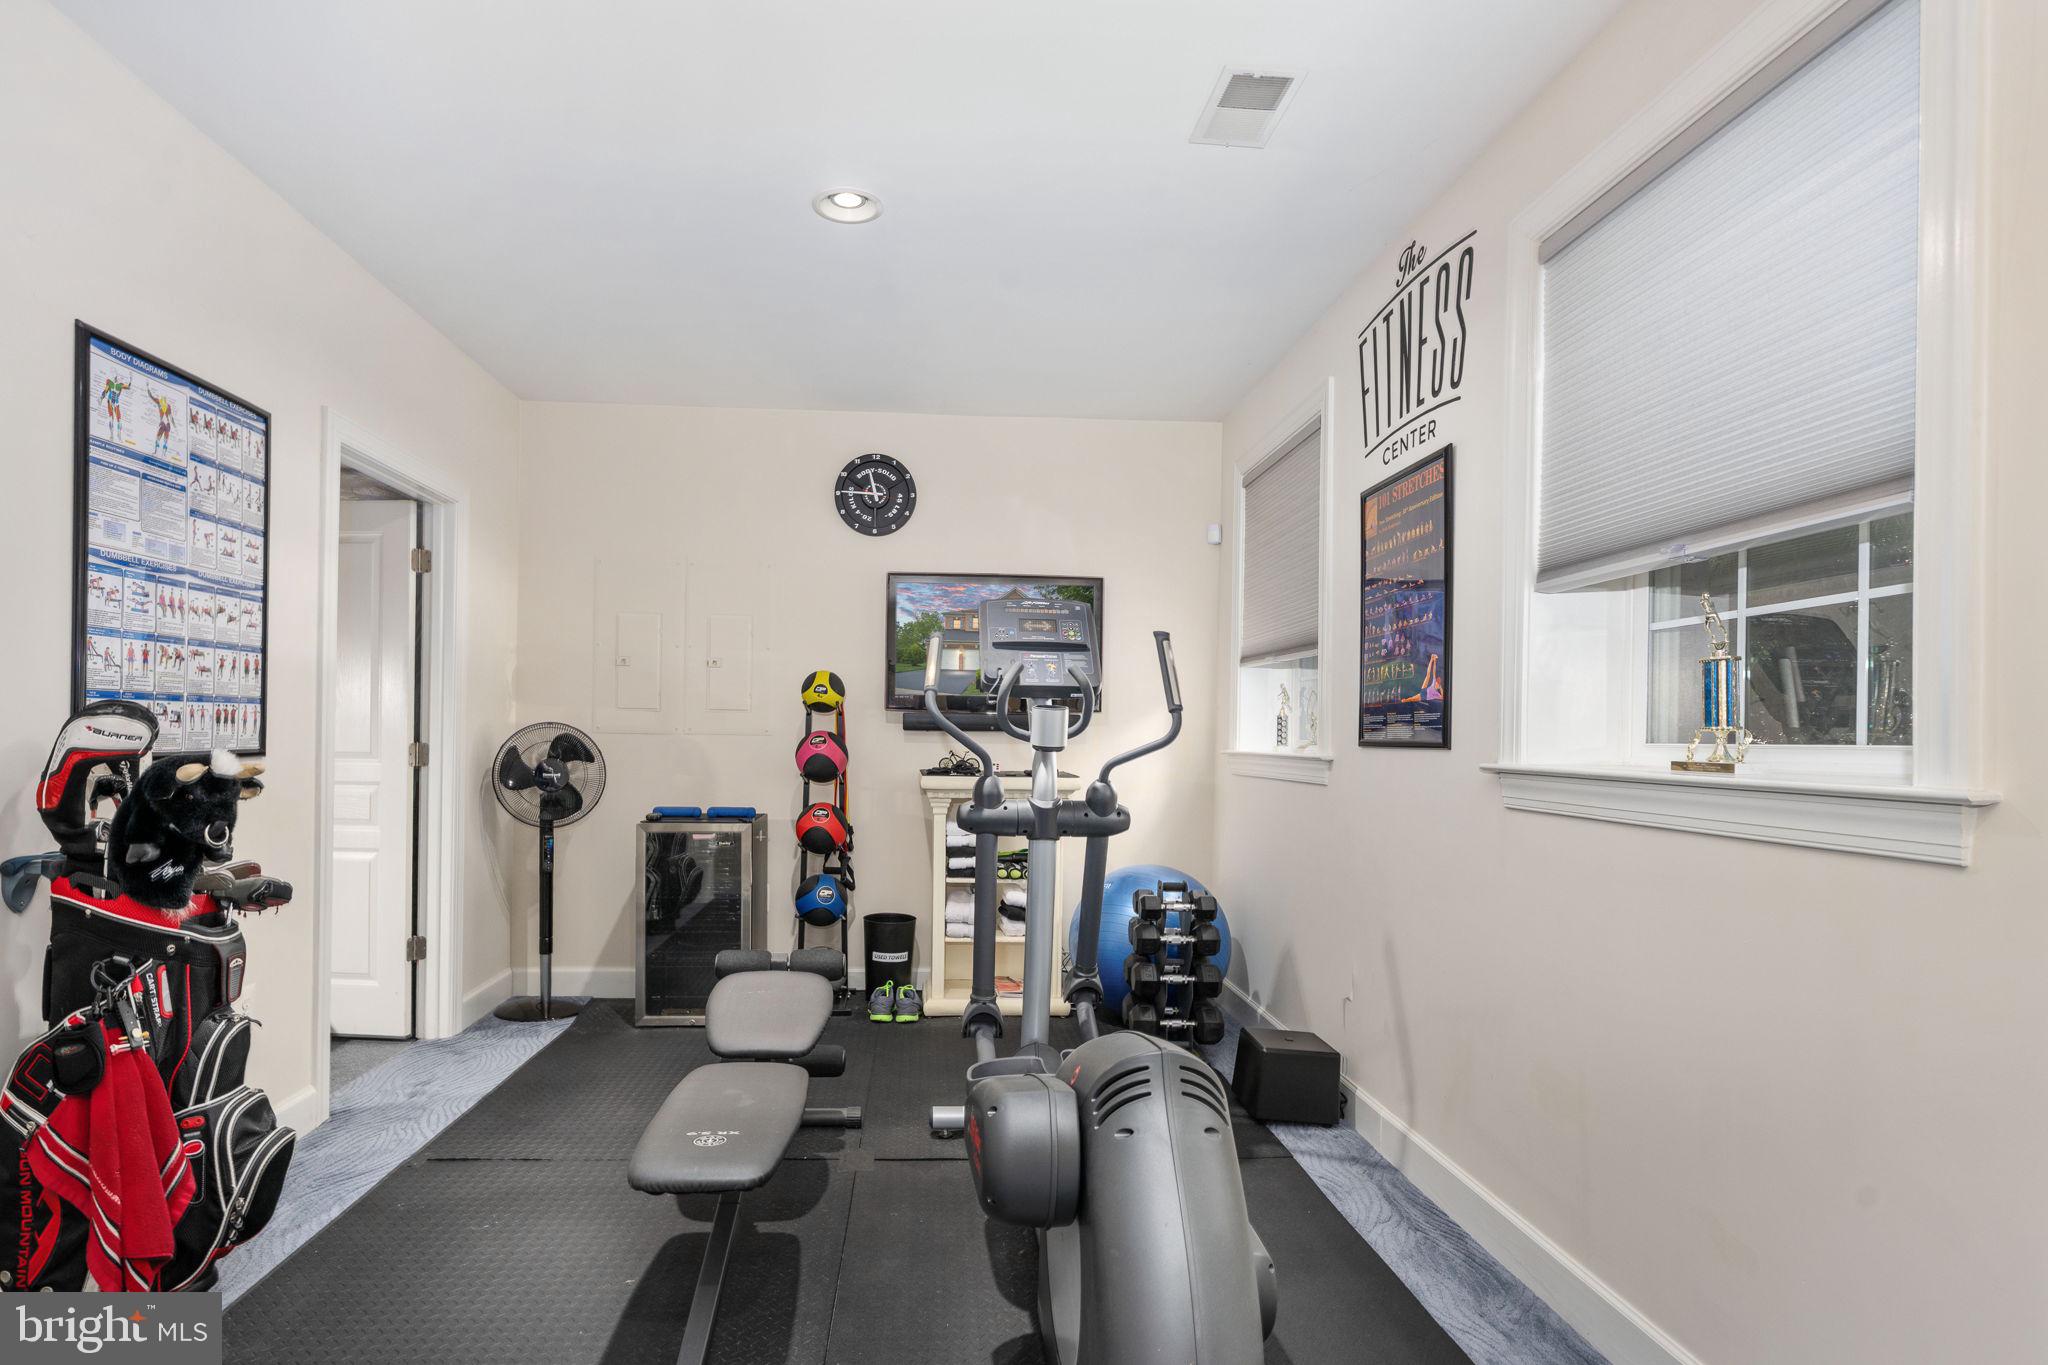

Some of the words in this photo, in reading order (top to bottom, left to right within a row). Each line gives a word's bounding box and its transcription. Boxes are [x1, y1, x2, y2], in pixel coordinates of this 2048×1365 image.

[1396, 240, 1427, 287] The
[111, 347, 131, 362] BODY
[133, 358, 168, 380] DIAGRAMS
[1359, 246, 1474, 448] FITNESS
[1382, 420, 1437, 465] CENTER
[856, 468, 897, 482] BODY-SOLID
[1392, 463, 1445, 503] STRETCHES
[100, 550, 139, 565] DUMBBELL
[140, 559, 177, 572] EXERCISES
[92, 727, 143, 742] BURNER
[146, 972, 157, 995] CART
[16, 1190, 33, 1290] MOUNTAIN
